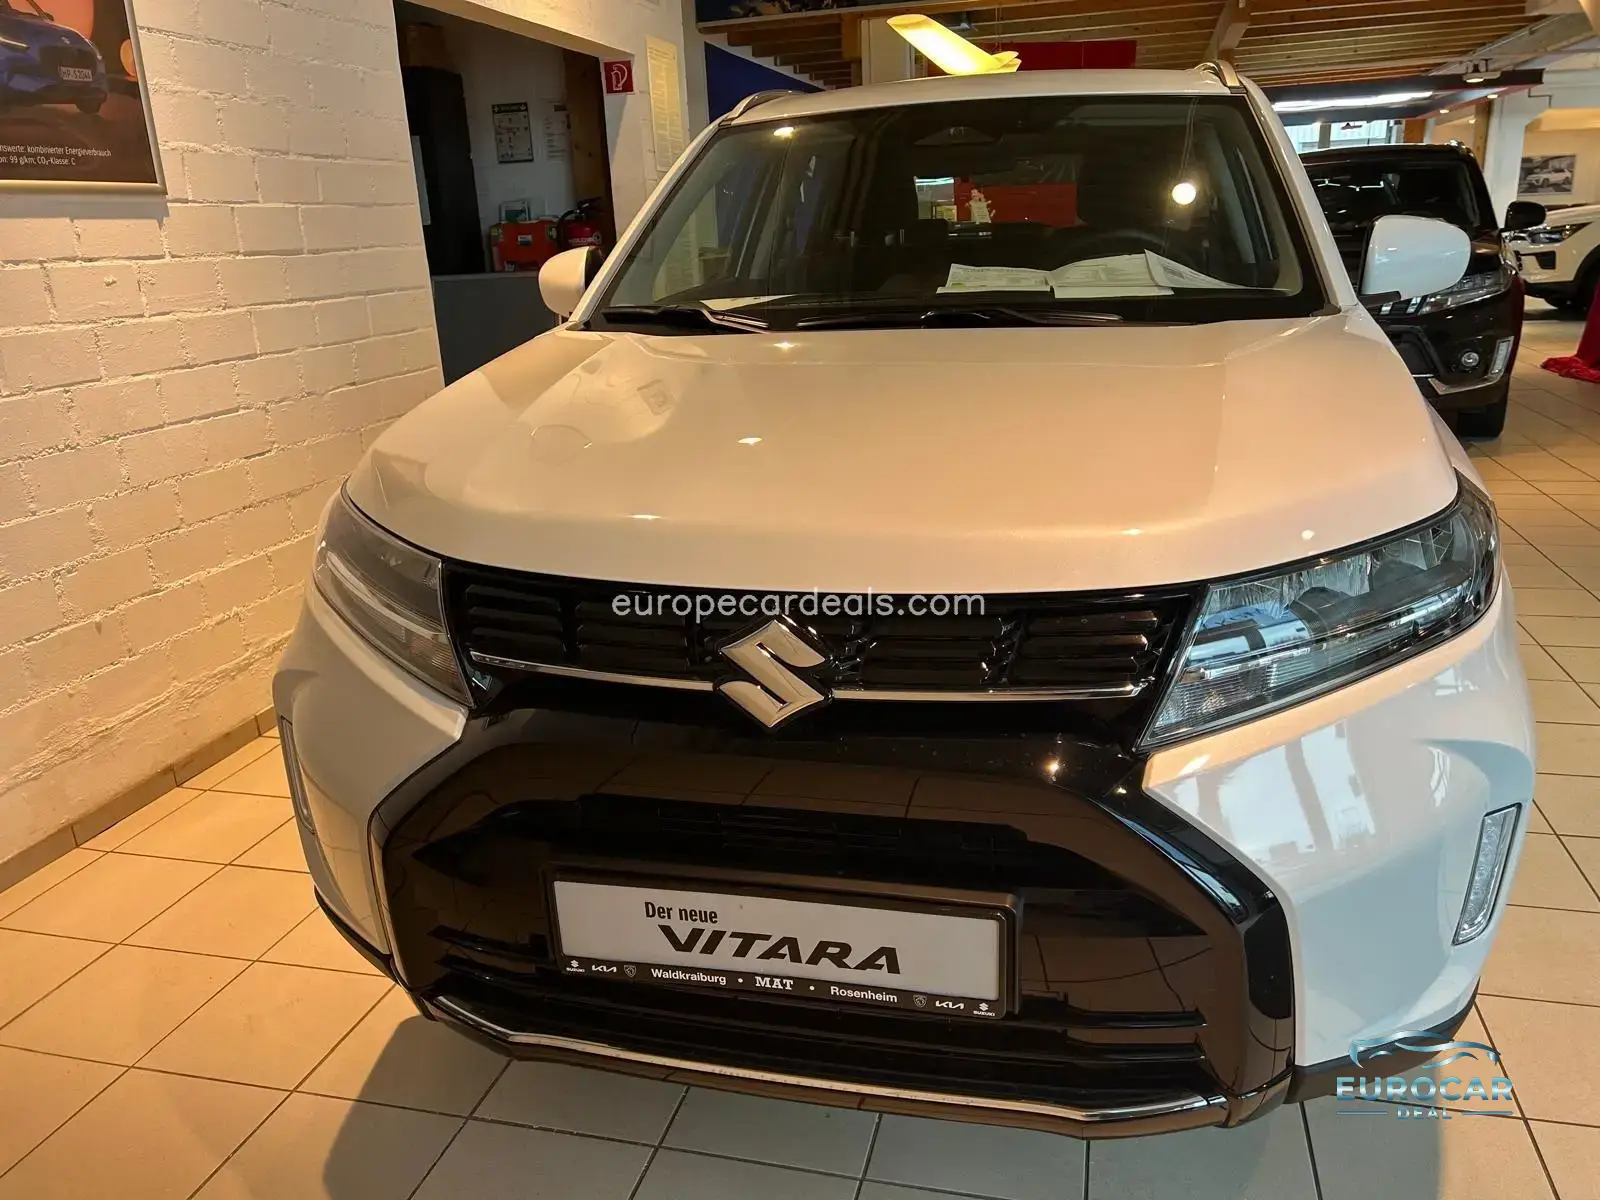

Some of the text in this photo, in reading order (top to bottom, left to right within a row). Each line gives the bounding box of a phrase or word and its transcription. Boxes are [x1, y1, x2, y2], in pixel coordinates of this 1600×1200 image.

[10, 155, 18, 164] 99
[27, 145, 64, 154] kombinierter
[65, 146, 112, 157] Energieverbrauch
[644, 901, 718, 924] Der neue
[657, 924, 901, 975] VITARA
[651, 968, 727, 985] Waldkraiburg
[755, 976, 793, 990] MAT
[830, 986, 898, 1003] Rosenheim
